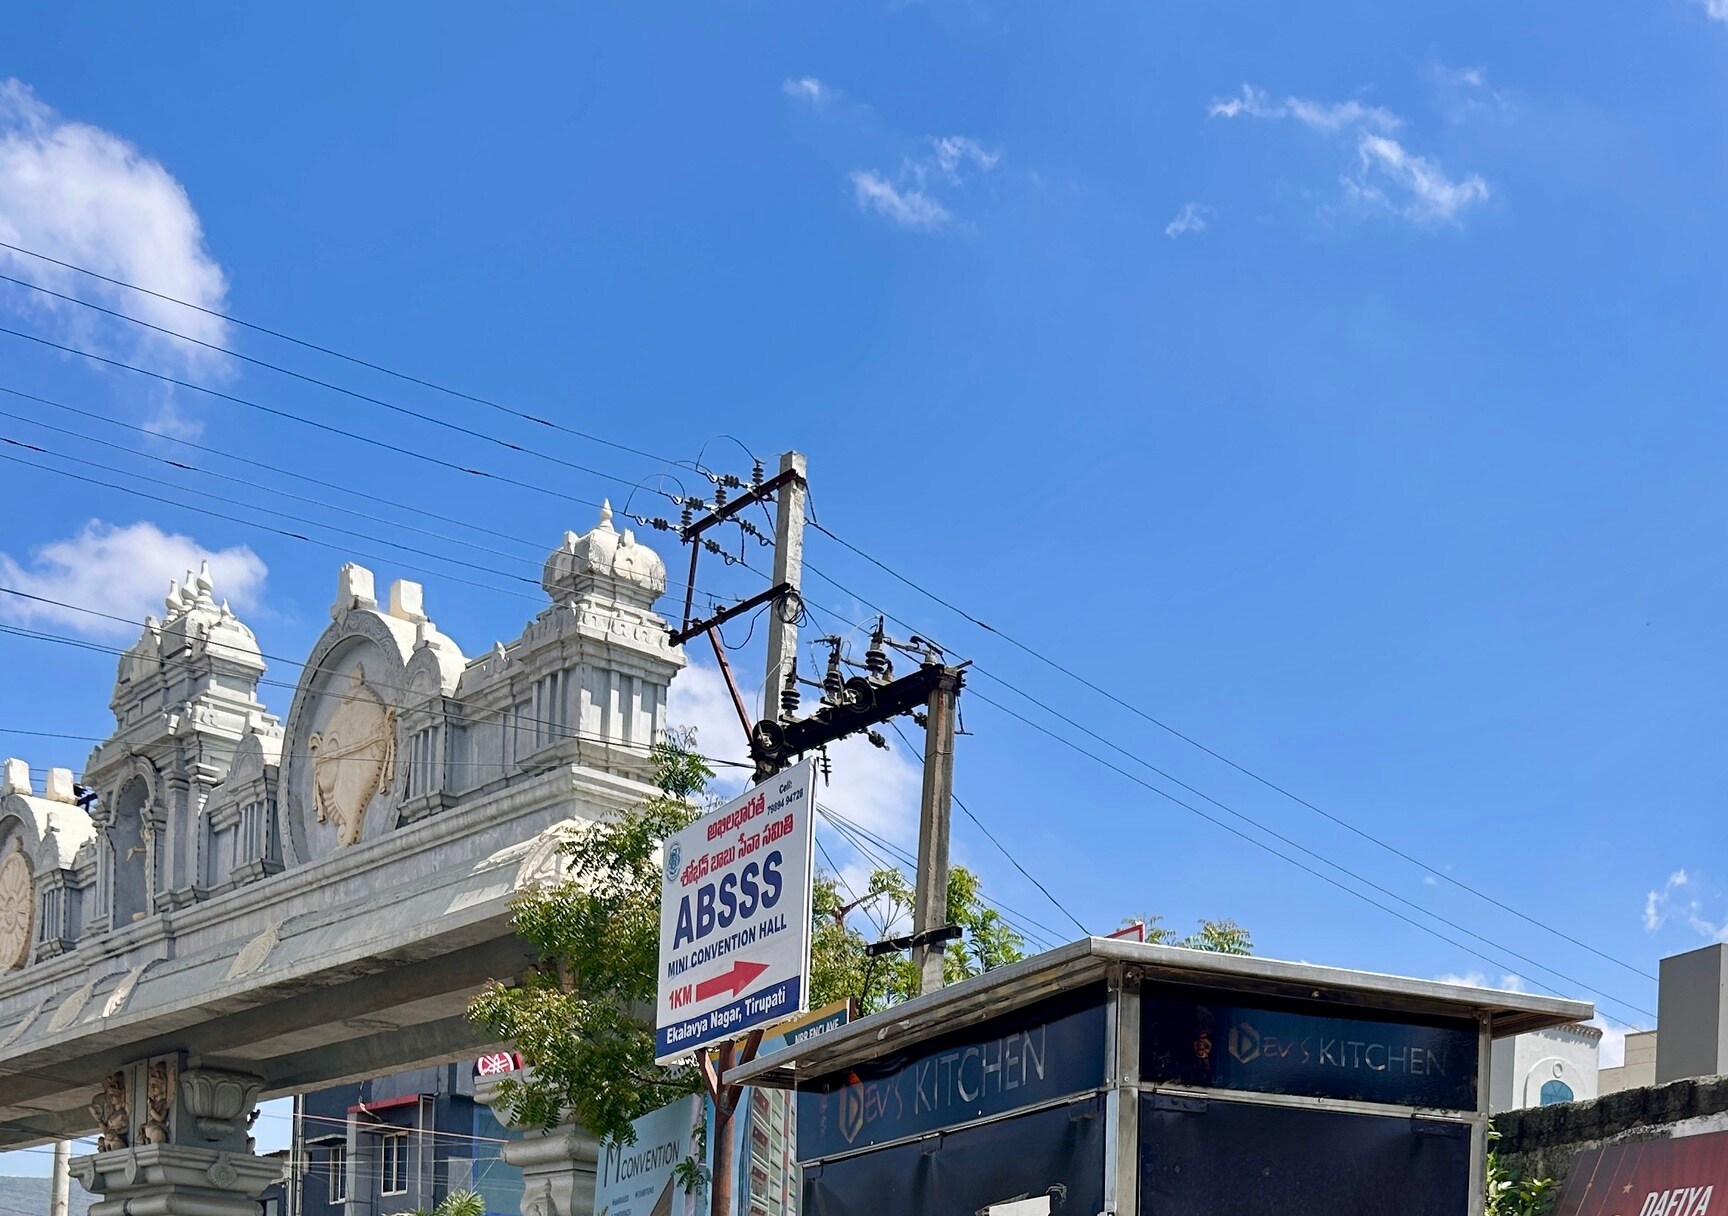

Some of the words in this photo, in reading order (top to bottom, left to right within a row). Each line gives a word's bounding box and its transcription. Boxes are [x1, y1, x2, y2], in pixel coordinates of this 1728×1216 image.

[673, 850, 783, 950] ABSSS
[668, 960, 688, 978] MINI
[691, 925, 756, 968] CONVENTION
[759, 914, 787, 940] HALL
[666, 1021, 708, 1045] Ekalavya
[711, 1006, 742, 1029] Nagar,
[745, 986, 787, 1016] Tirupati
[668, 984, 692, 1010] 1KM
[914, 1023, 1047, 1116] KITCHEN
[1318, 1038, 1446, 1077] KITCHEN
[621, 1141, 680, 1181] CONVENTION
